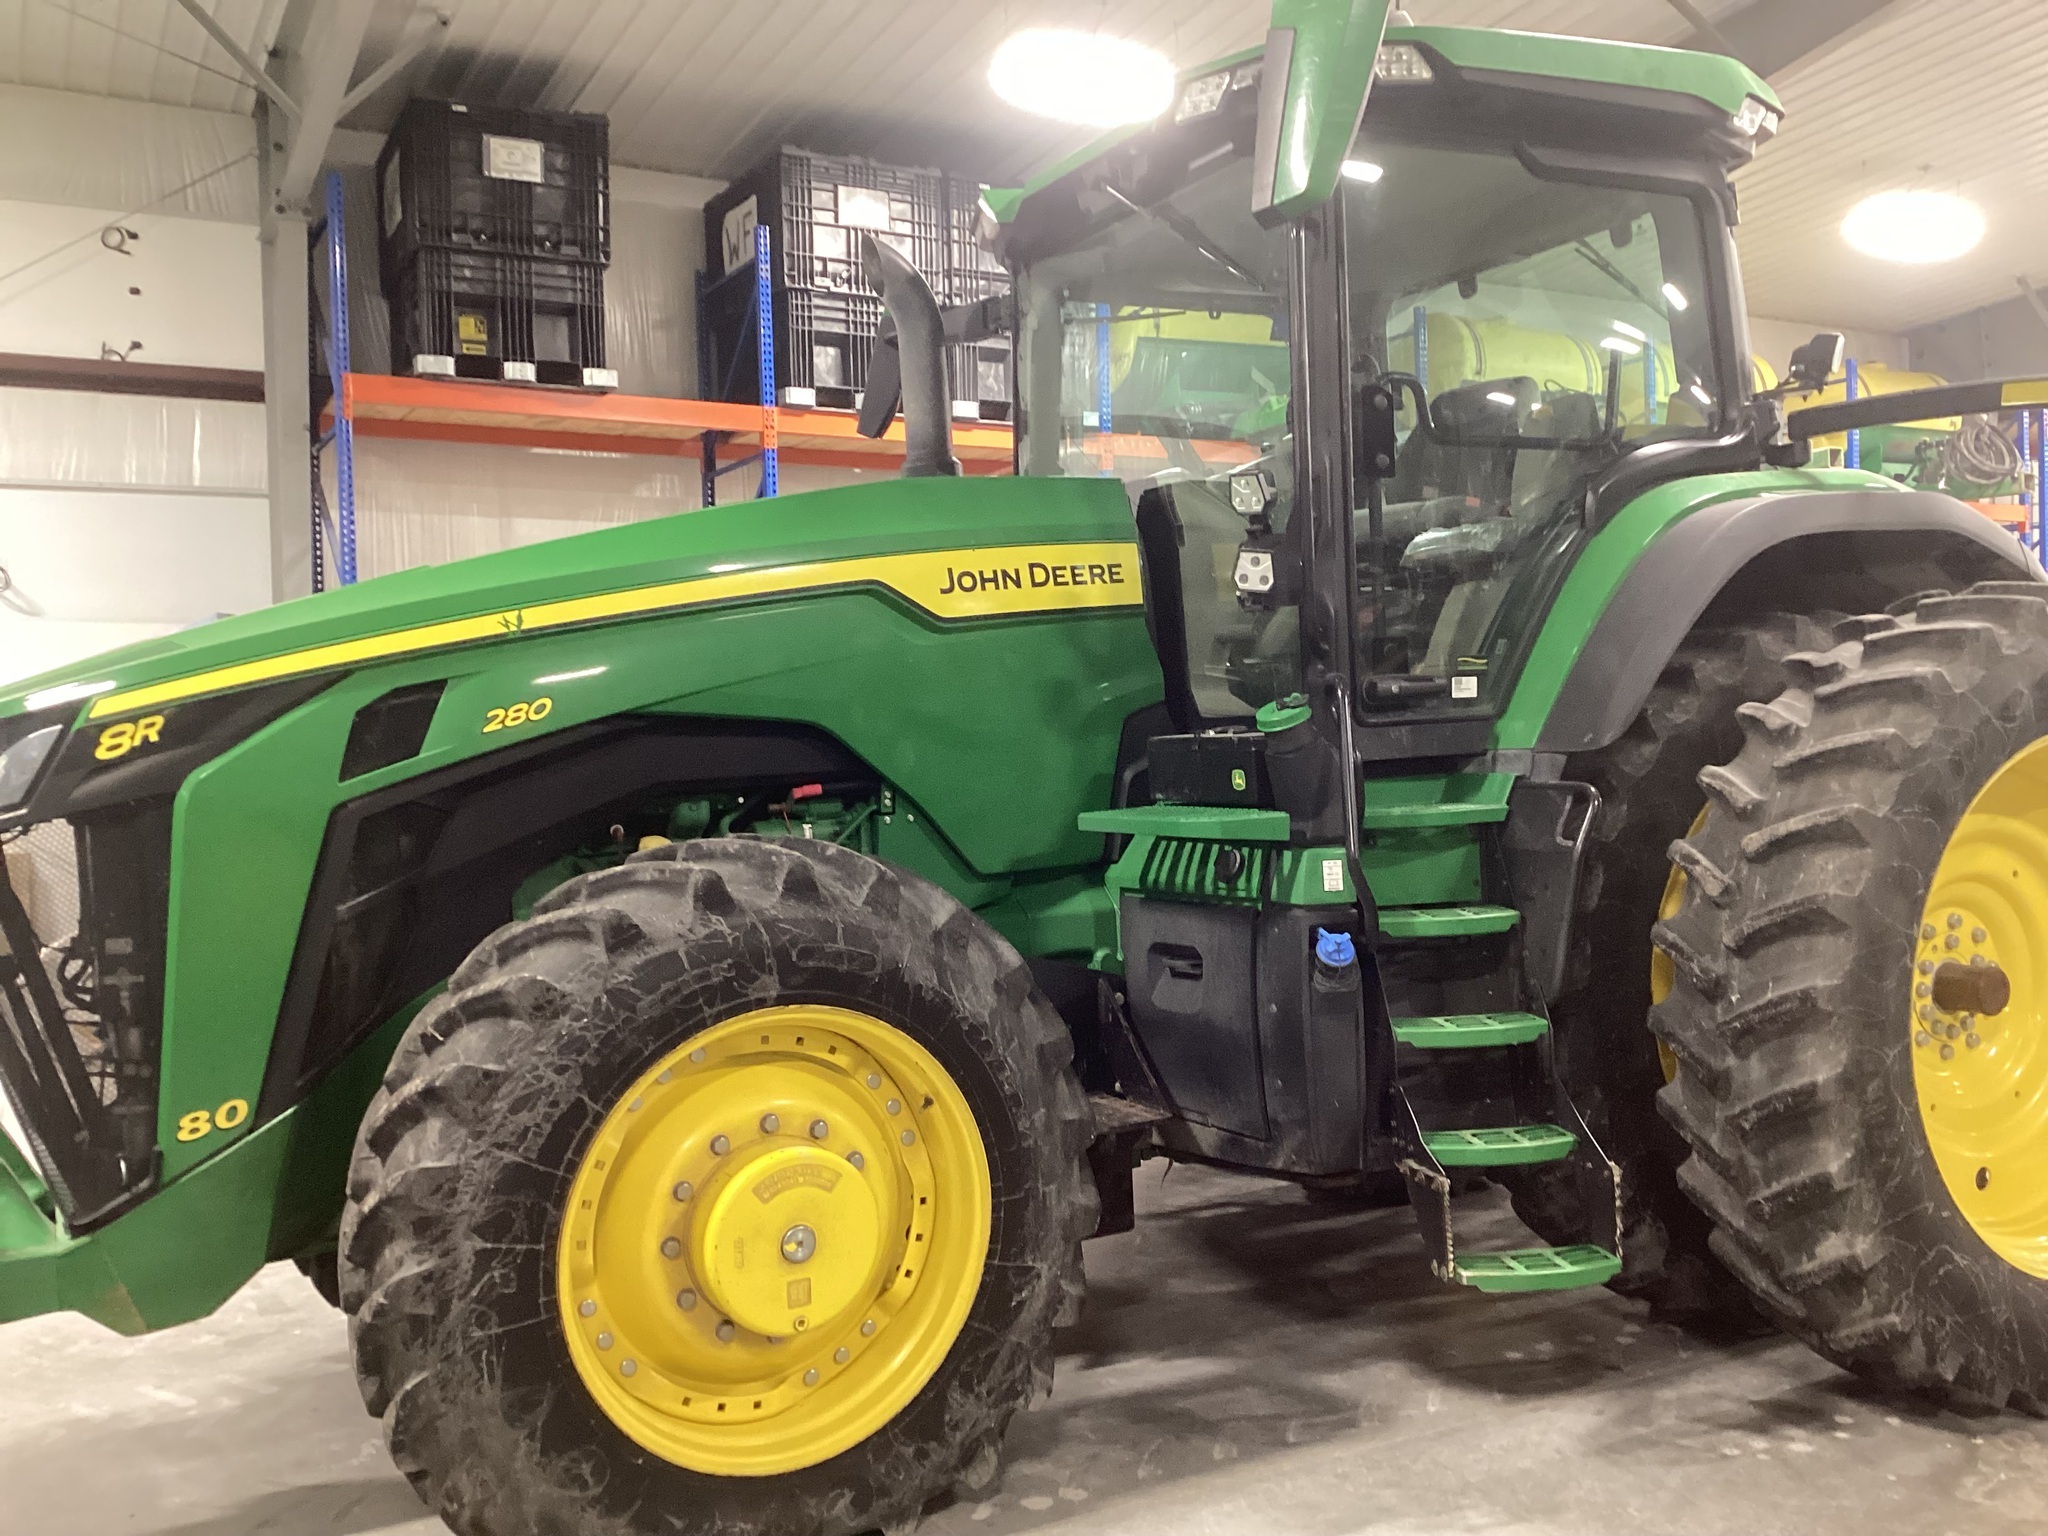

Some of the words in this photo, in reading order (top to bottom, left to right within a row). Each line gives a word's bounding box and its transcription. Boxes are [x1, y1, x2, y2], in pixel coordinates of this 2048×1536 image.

[725, 210, 752, 267] WF
[940, 567, 1022, 595] JOHN
[1028, 562, 1125, 588] DEERE
[94, 714, 165, 760] 8R
[482, 697, 553, 733] 280
[176, 1098, 248, 1142] 80
